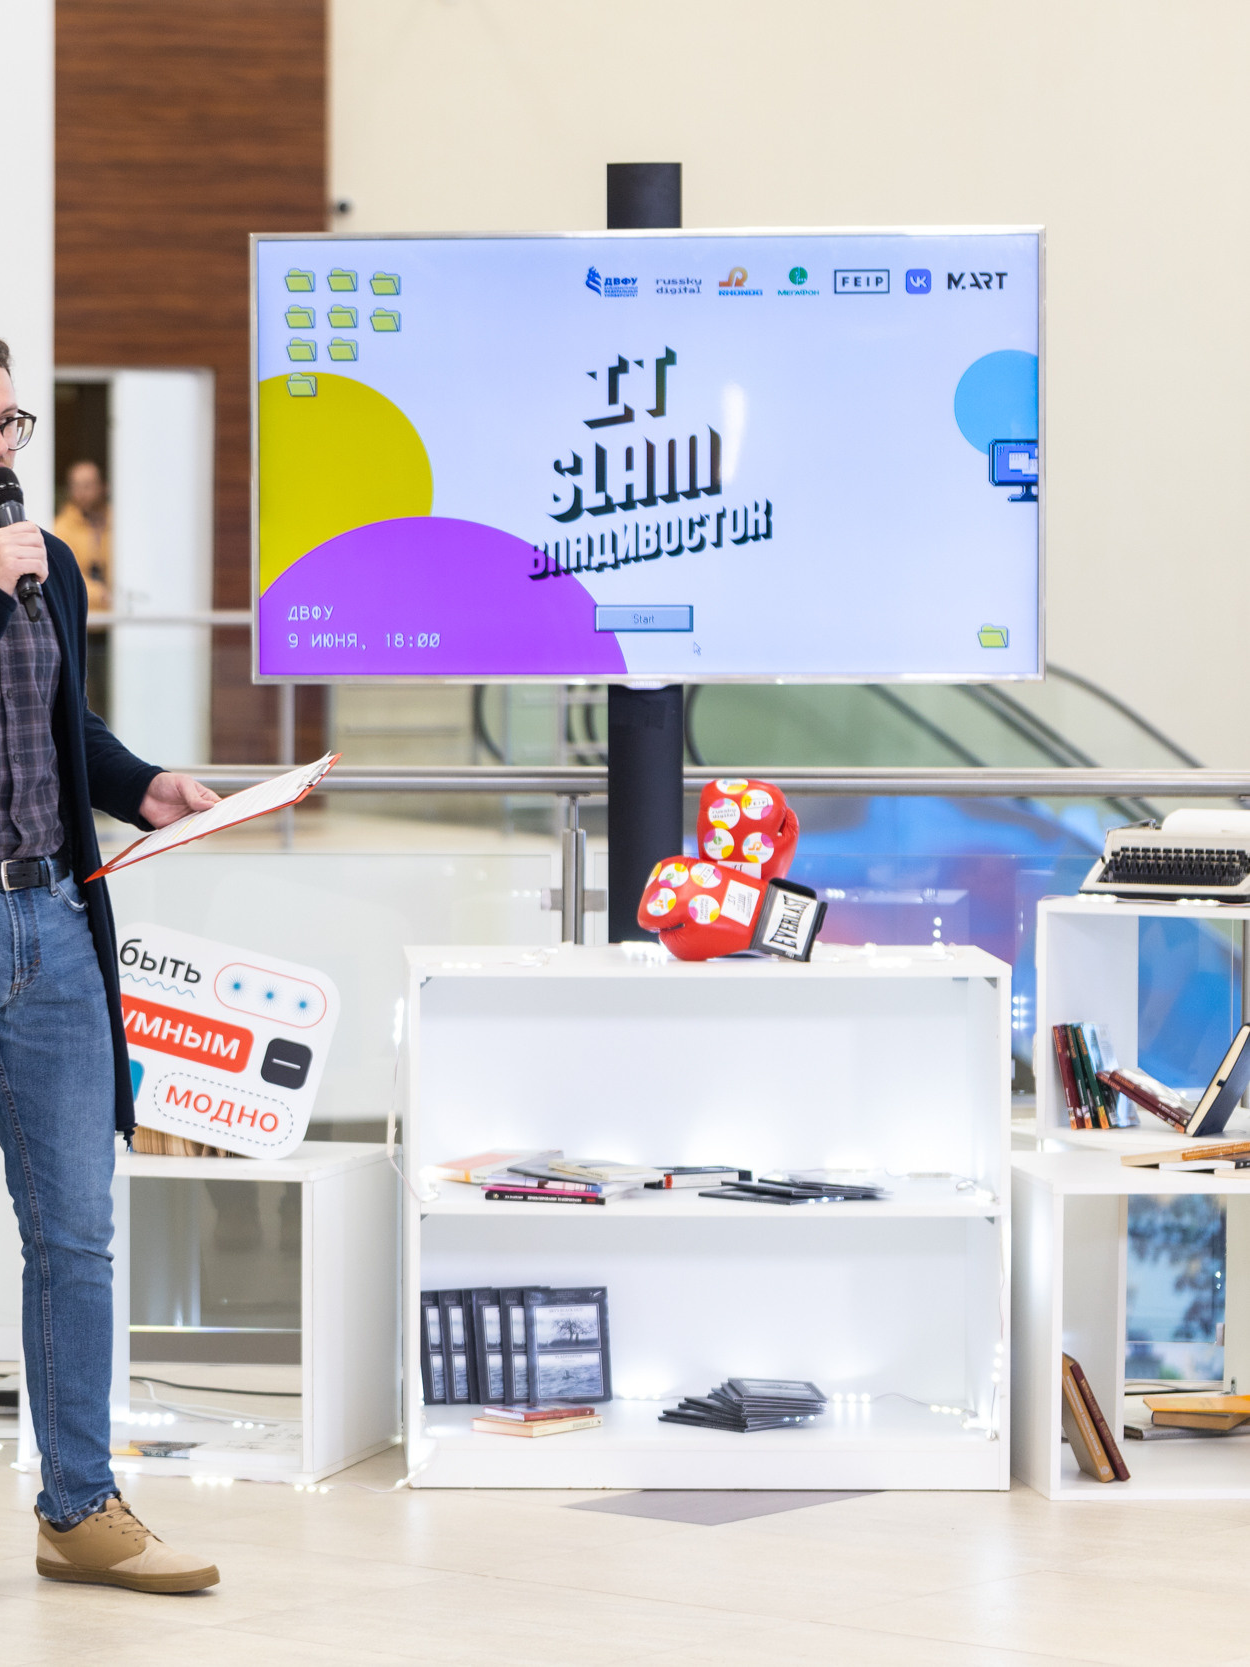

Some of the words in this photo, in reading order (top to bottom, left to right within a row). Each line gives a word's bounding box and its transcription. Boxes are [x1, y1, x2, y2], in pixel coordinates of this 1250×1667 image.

[603, 277, 639, 286] ДВФУ
[655, 277, 703, 286] russky
[841, 275, 884, 287] FEIP
[656, 286, 702, 295] digital
[547, 424, 722, 524] SLAM
[527, 498, 773, 581] ВЛАДИВОСТОК
[287, 605, 335, 622] ДВФУ
[633, 613, 655, 625] Start
[288, 633, 300, 649] 9
[311, 633, 368, 651] ИЮНЯ,
[385, 632, 442, 649] 18:00
[769, 894, 810, 950] EVERLAST
[119, 938, 202, 984] быть
